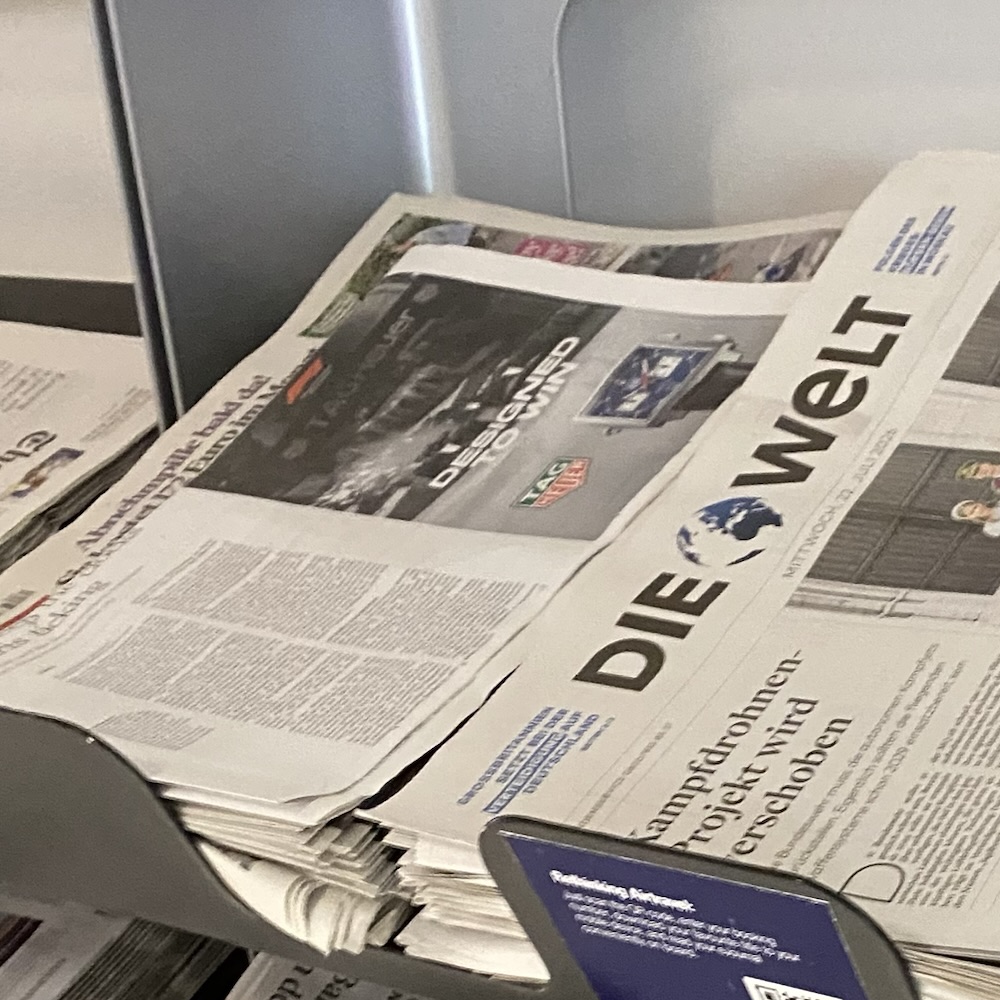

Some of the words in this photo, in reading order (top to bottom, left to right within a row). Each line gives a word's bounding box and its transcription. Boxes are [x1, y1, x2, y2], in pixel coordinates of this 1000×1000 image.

[195, 400, 244, 438] bald
[428, 335, 582, 489] DESIGNED
[470, 427, 523, 468] TO
[519, 360, 579, 418] WIN
[179, 429, 241, 474] Euro
[517, 459, 571, 504] TAG
[534, 457, 591, 507] HEUER
[571, 568, 730, 697] DIE
[559, 710, 584, 731] AUF
[745, 696, 819, 760] wird
[522, 713, 600, 795] DEUTSCHLAND
[717, 714, 854, 862] erschoben
